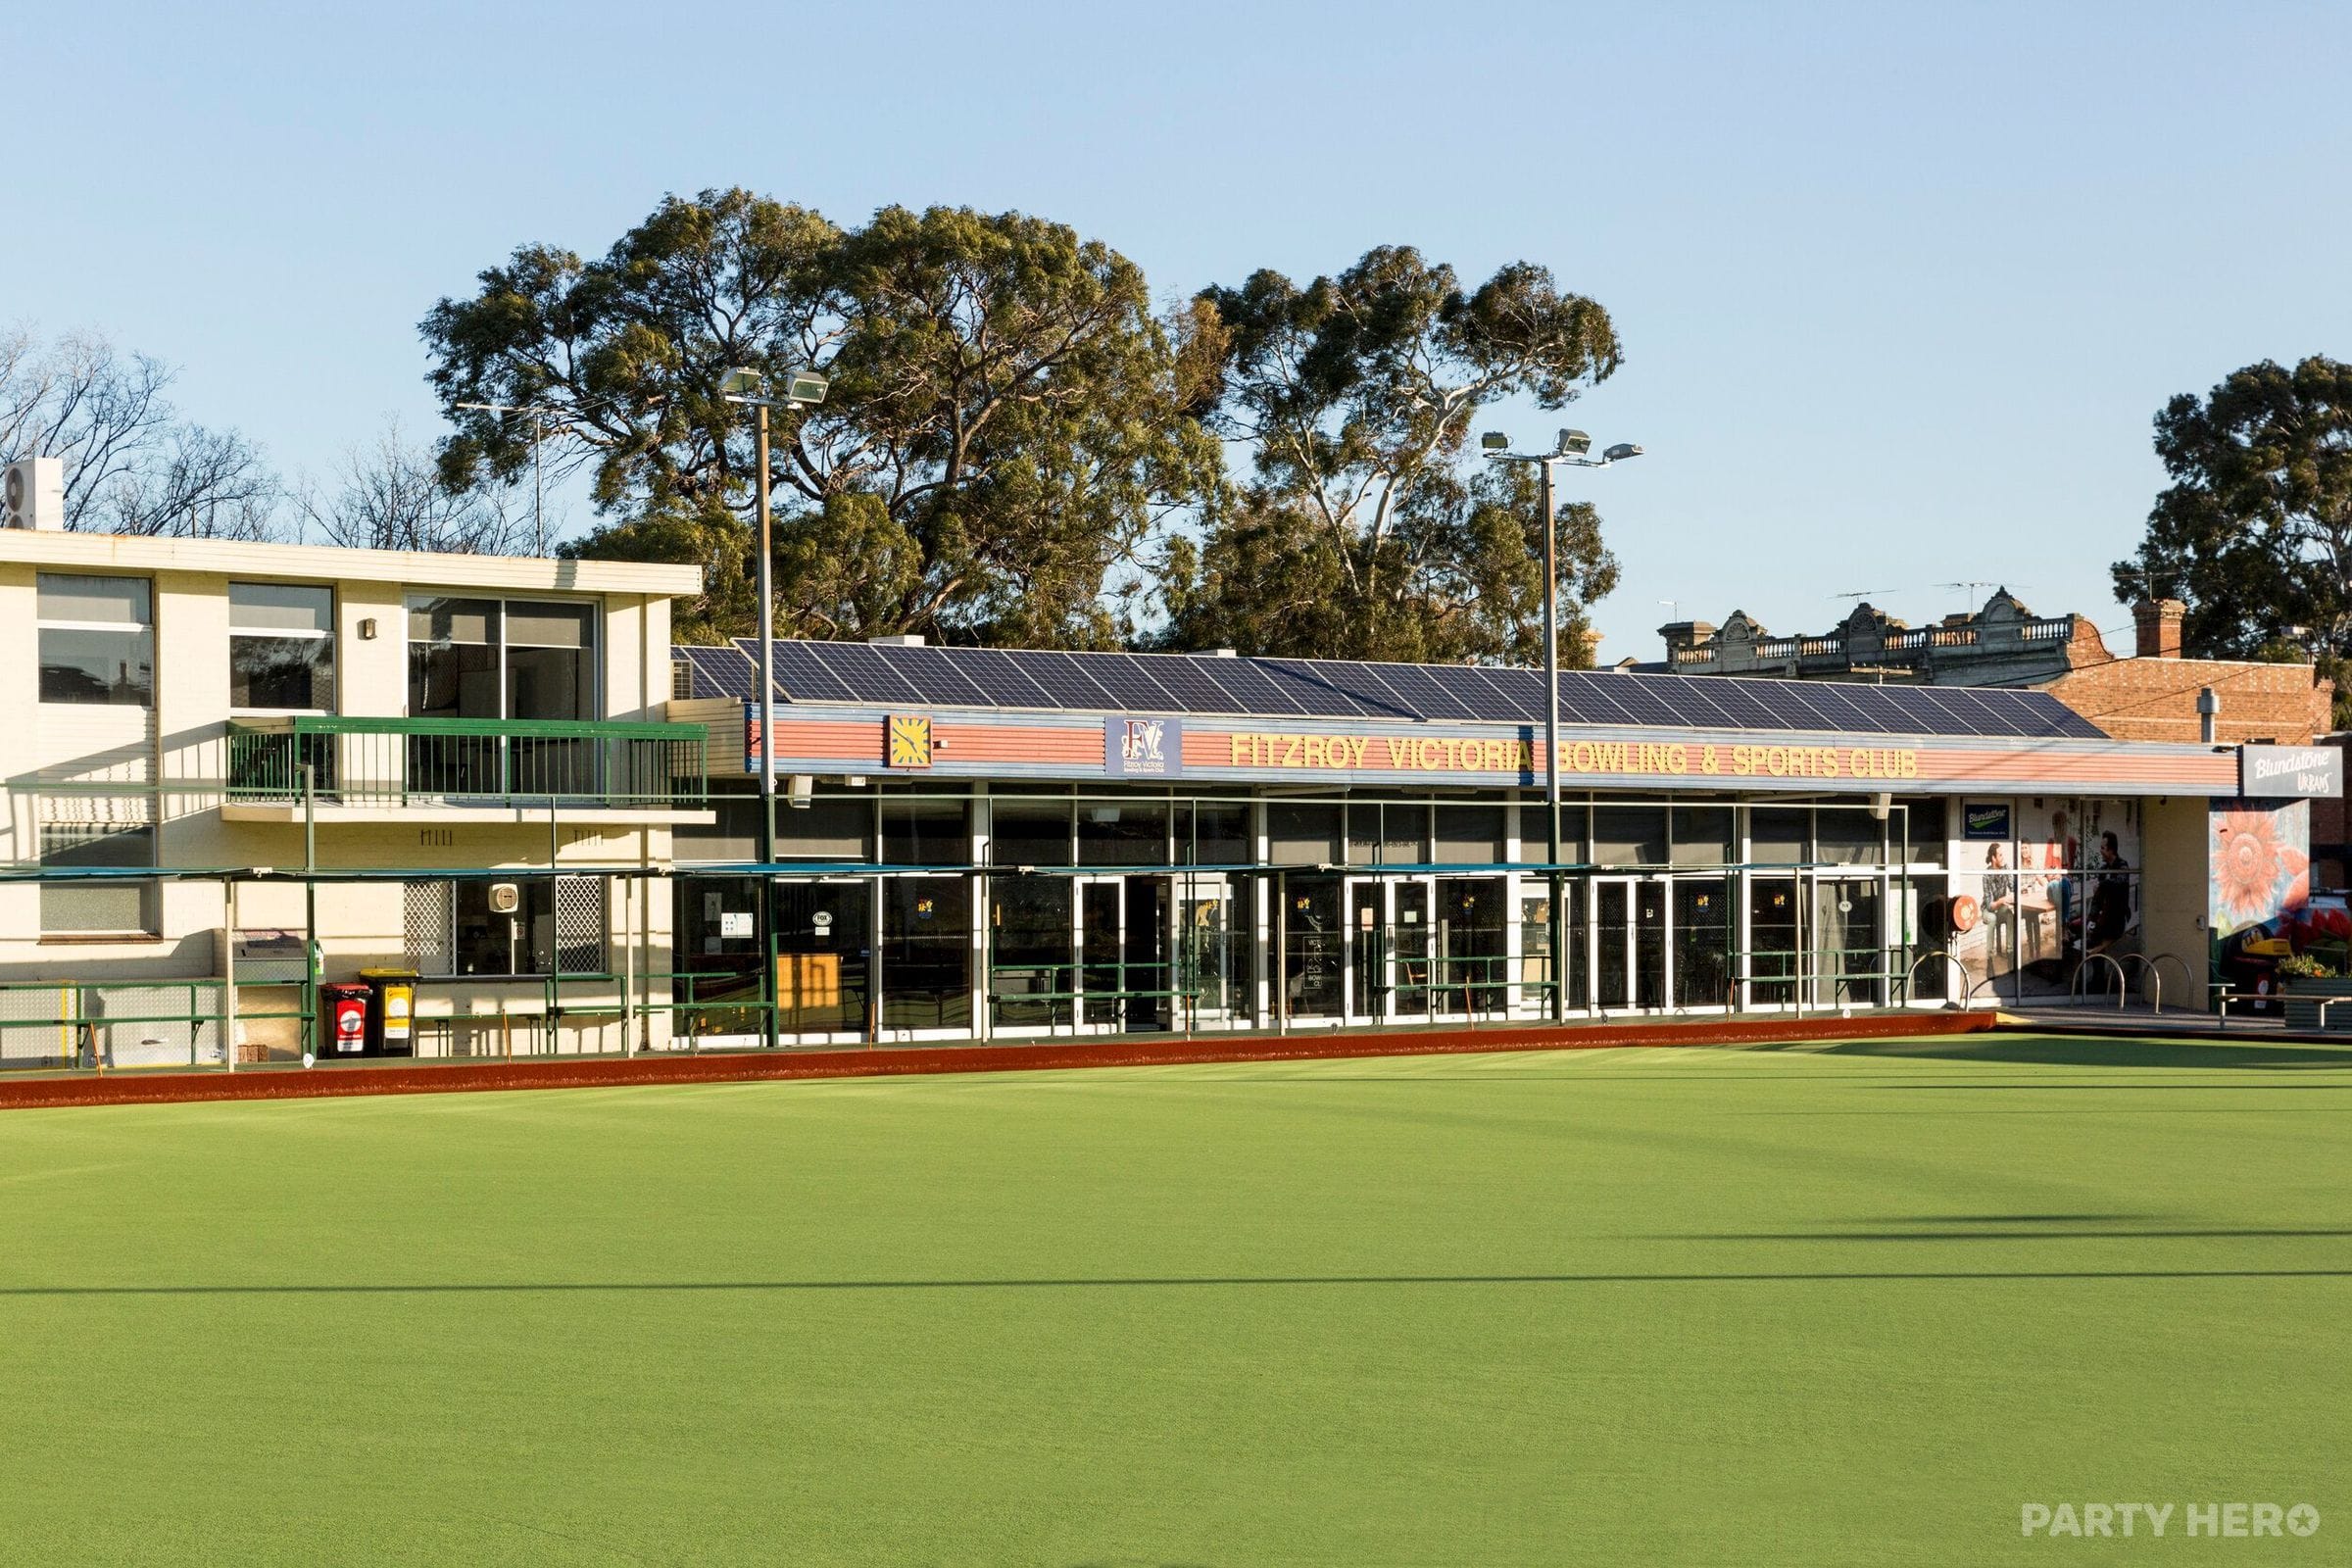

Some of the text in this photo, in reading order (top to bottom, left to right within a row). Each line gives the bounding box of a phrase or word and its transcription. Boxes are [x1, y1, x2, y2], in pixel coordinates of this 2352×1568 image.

[1230, 733, 1918, 779] FITZROY VICTORIA BOWLING & SPORTS CLUB
[2255, 751, 2330, 779] Blundstone
